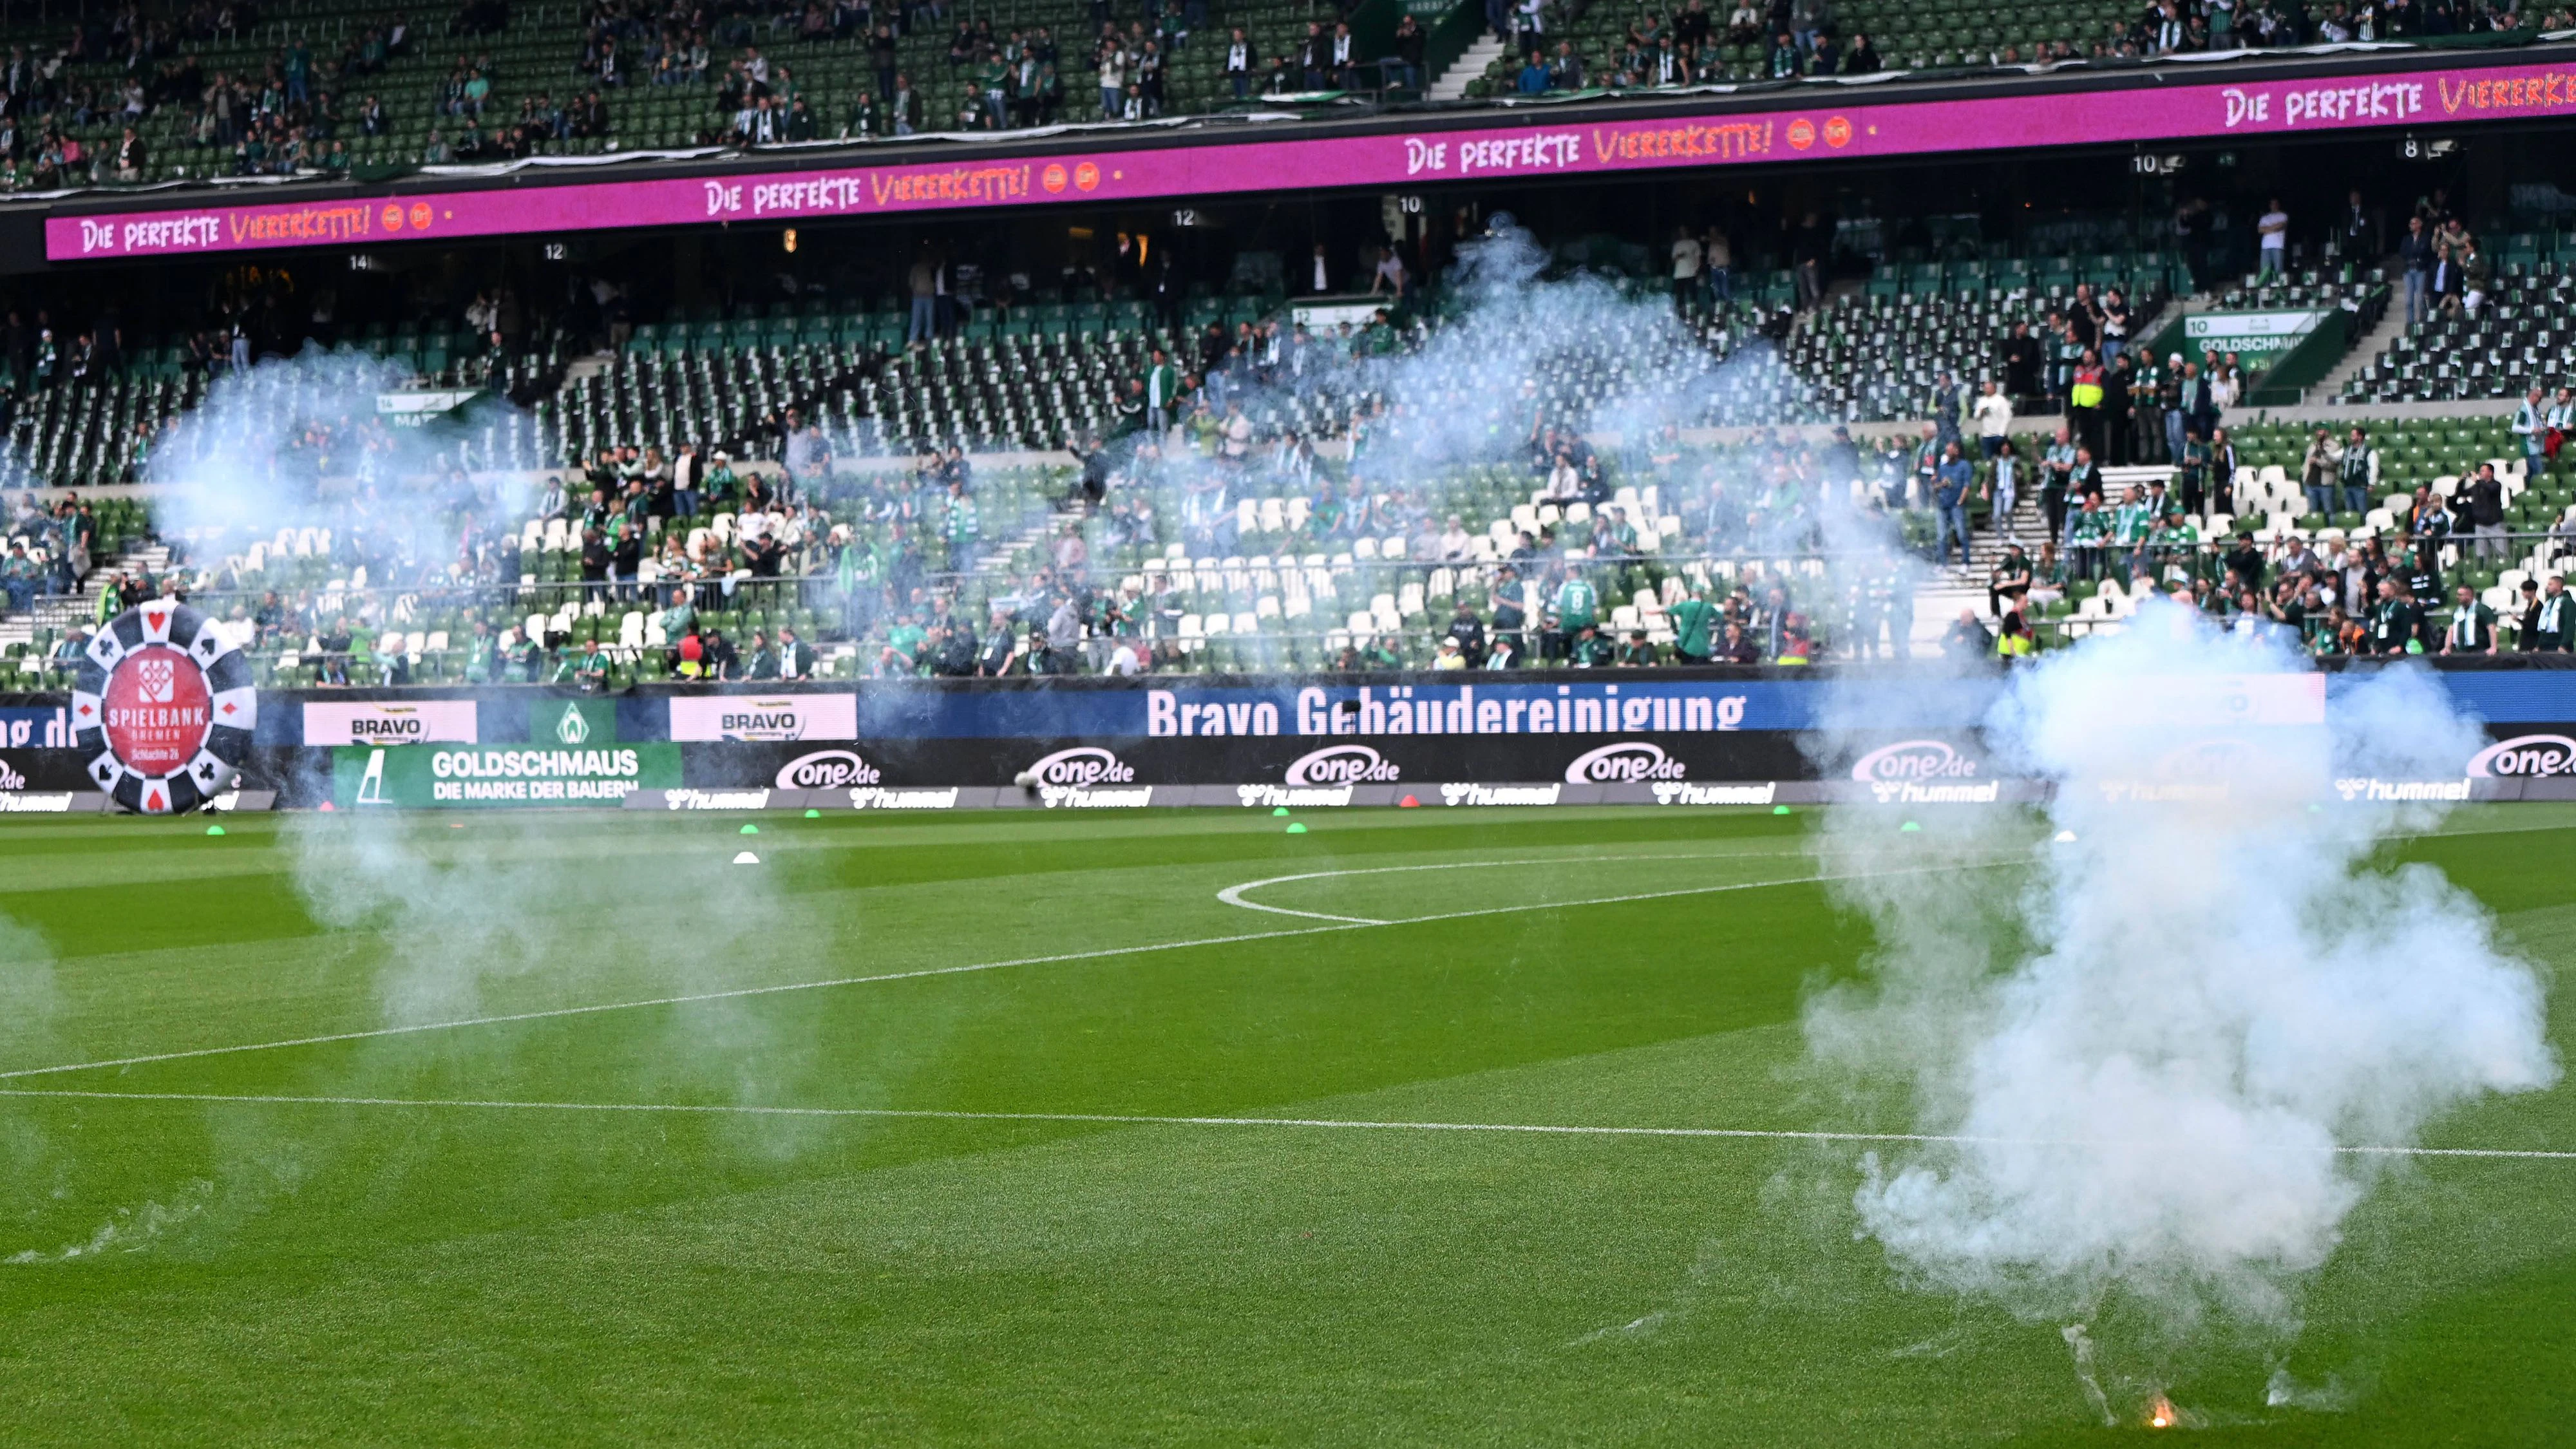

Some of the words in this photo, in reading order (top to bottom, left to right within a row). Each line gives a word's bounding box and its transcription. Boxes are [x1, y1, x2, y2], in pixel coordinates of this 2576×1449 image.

[2404, 140, 2418, 158] 8
[2133, 155, 2155, 173] 10
[1400, 196, 1420, 213] 10
[1174, 209, 1194, 226] 12
[545, 243, 564, 260] 12
[350, 255, 368, 270] 14
[2191, 321, 2208, 333] 10
[109, 707, 204, 727] SPIELBANK
[1148, 690, 1278, 736] Bravo
[1297, 685, 1747, 735] Gebäudereinigung
[352, 719, 421, 734] BRAVO
[722, 714, 795, 729] BRAVO
[432, 750, 638, 777] GOLDSCHMAUS
[1048, 761, 1134, 782] one.de
[1310, 759, 1400, 781] one.de
[1591, 756, 1685, 779] one.de
[1879, 753, 1976, 777] one.de
[798, 762, 880, 785] one.de
[433, 782, 462, 800] DIE
[464, 781, 527, 799] MARKE
[530, 781, 565, 799] DER
[567, 781, 638, 799] BAUERN
[1900, 780, 1998, 802] hummel
[2367, 777, 2471, 800] hummel
